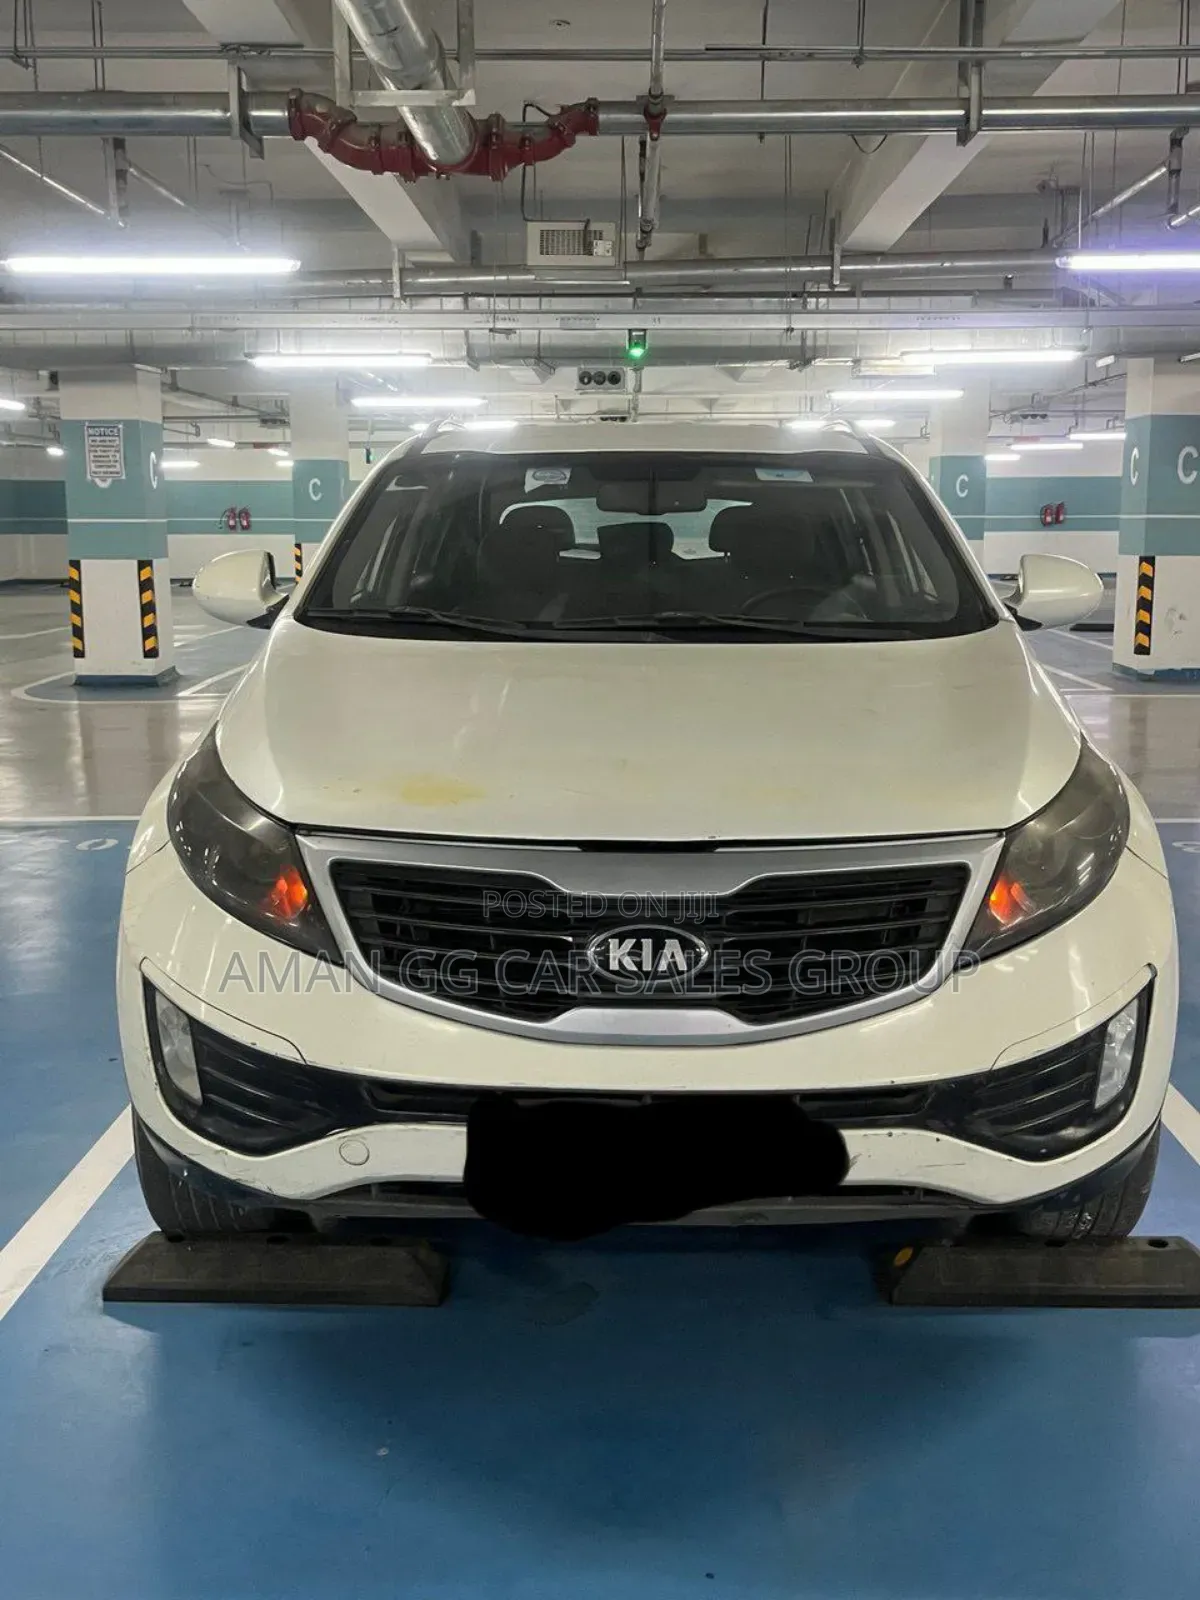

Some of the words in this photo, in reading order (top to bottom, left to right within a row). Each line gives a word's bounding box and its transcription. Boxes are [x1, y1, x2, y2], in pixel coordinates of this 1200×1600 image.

[88, 427, 119, 436] NOTICE
[1130, 446, 1140, 486] C
[1177, 445, 1199, 485] C
[309, 478, 322, 501] C
[956, 474, 969, 498] C
[608, 938, 688, 972] KIA
